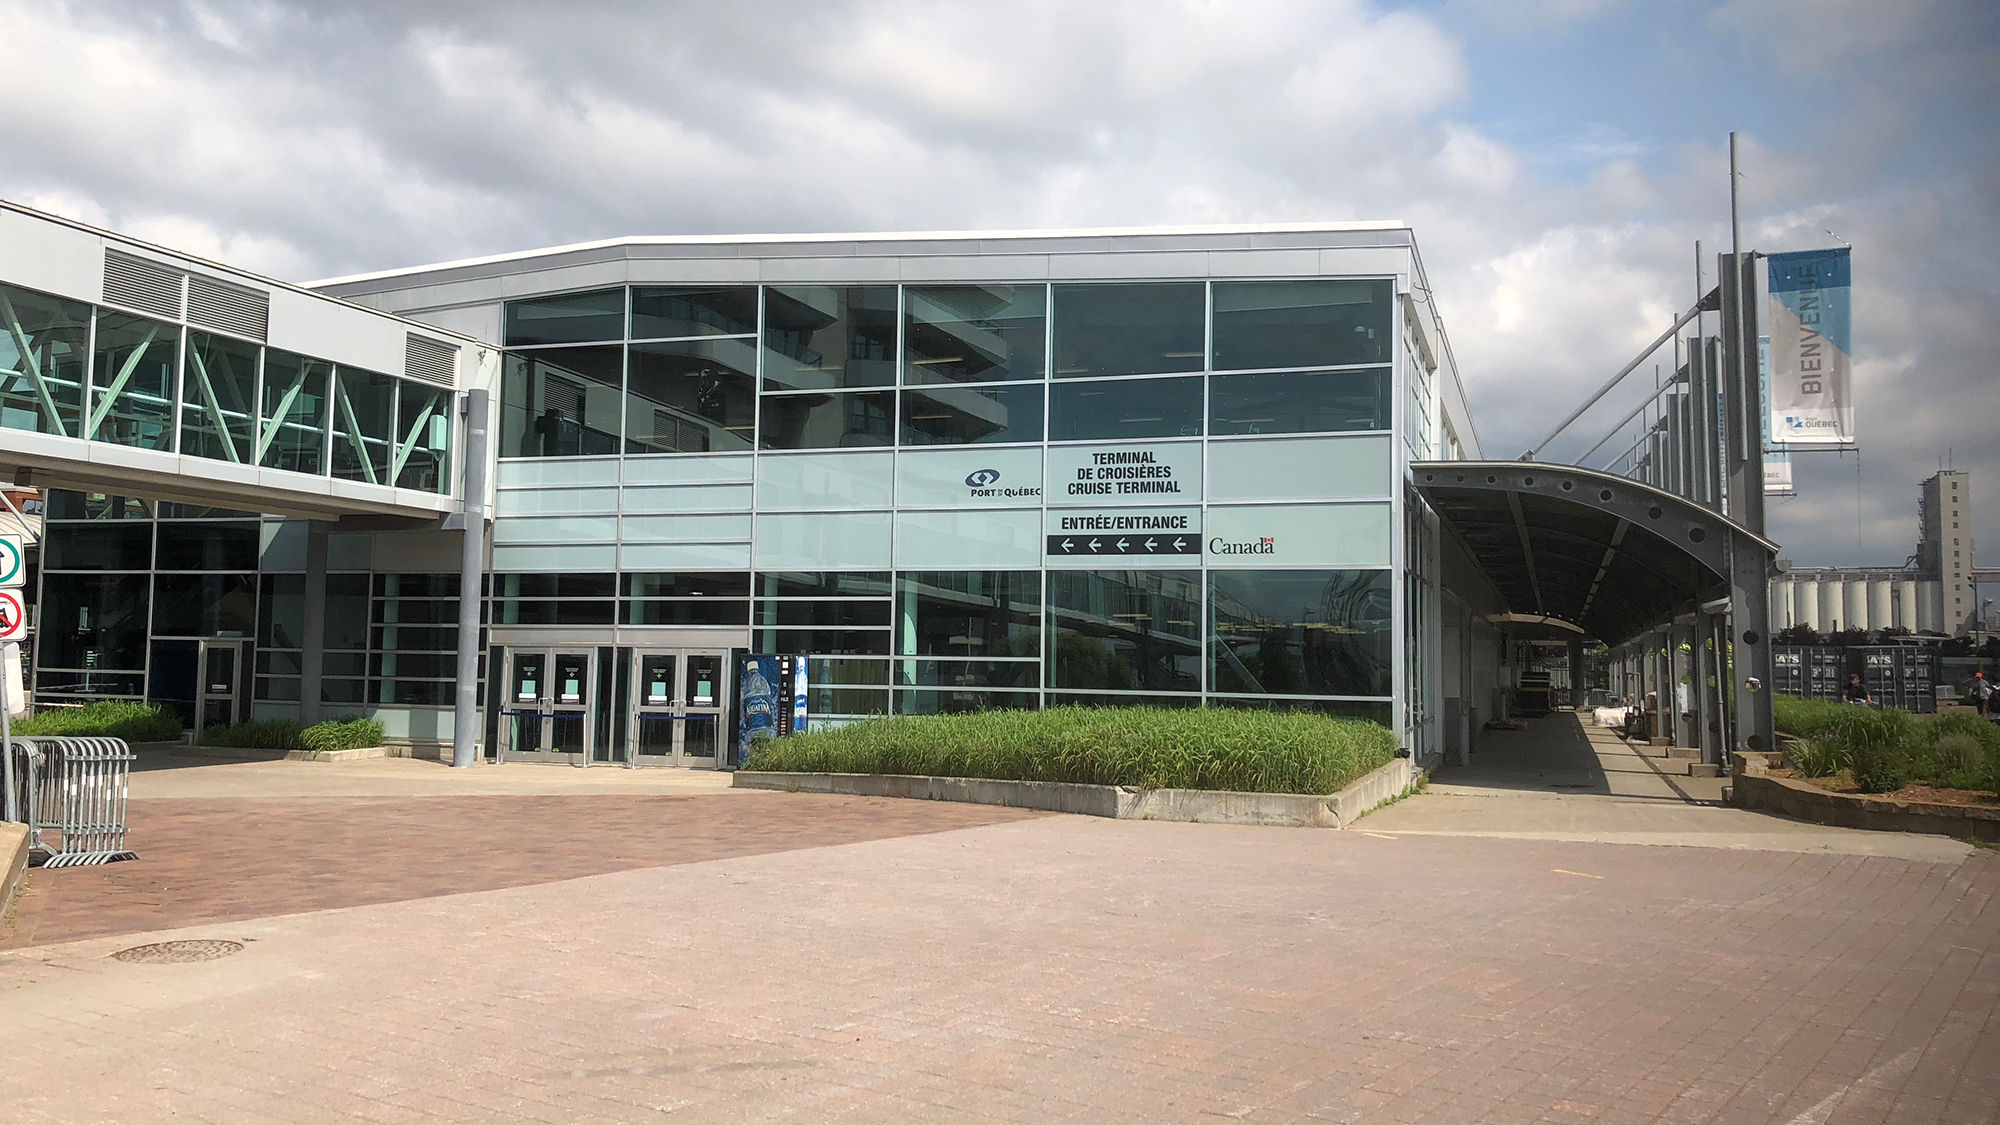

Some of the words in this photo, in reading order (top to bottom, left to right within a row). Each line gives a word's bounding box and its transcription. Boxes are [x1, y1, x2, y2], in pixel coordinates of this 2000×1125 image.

[1800, 264, 1822, 394] BIENVENUE
[1805, 420, 1838, 428] QUÉBEC
[1092, 451, 1156, 465] TERMINAL
[1077, 467, 1093, 480] DE
[1097, 464, 1172, 479] CROISIÈRES
[970, 489, 996, 497] PORT
[1004, 485, 1041, 497] QUÉBEC
[1068, 482, 1112, 495] CRUISE
[1116, 480, 1181, 494] TERMINAL
[1061, 514, 1188, 530] ENTRÉE/ENTRANCE
[1209, 537, 1275, 554] Canada
